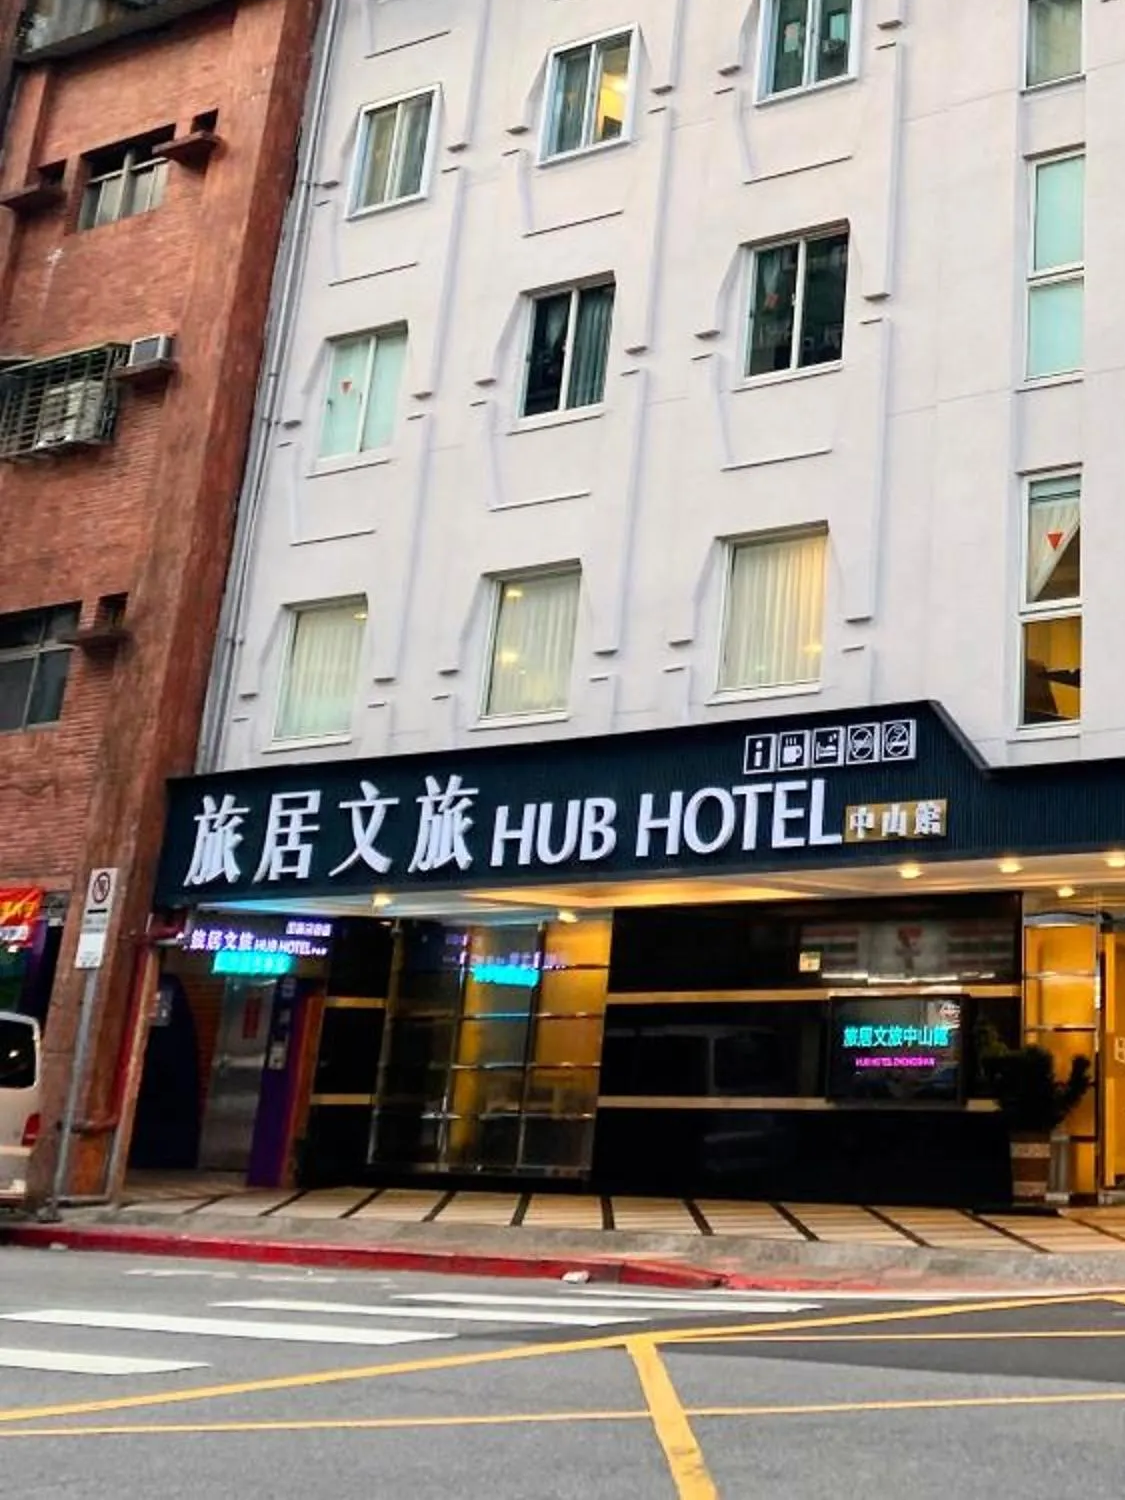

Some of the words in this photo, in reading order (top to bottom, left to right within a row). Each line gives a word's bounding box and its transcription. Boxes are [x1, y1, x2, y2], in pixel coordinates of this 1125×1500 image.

[183, 773, 480, 887] 旅居文旅
[489, 796, 618, 867] HUB
[635, 778, 844, 858] HOTEL
[849, 800, 943, 839] 中山館
